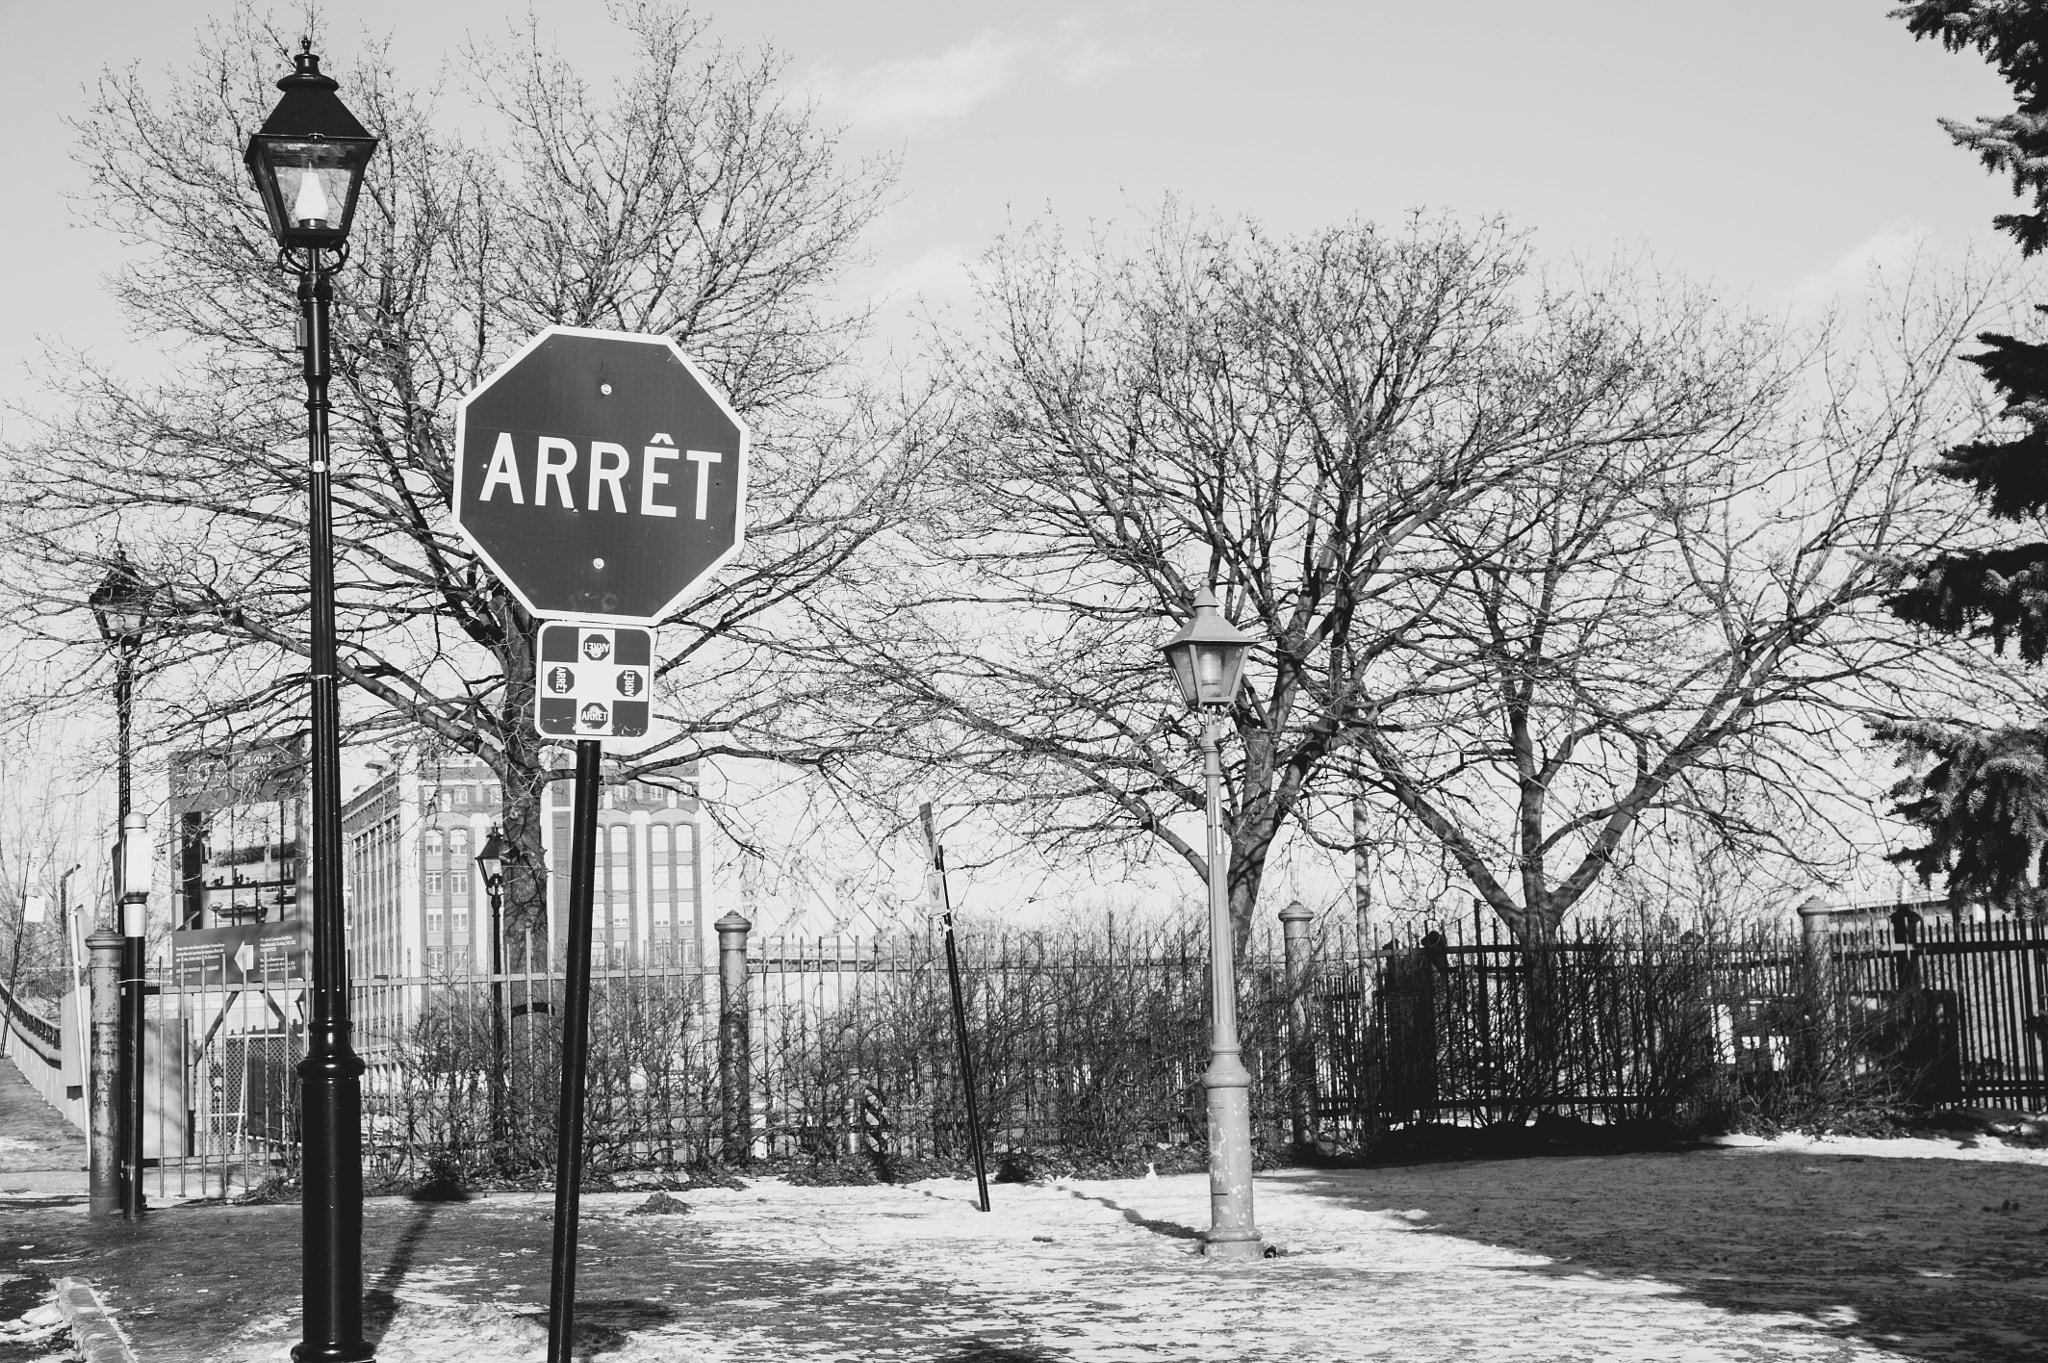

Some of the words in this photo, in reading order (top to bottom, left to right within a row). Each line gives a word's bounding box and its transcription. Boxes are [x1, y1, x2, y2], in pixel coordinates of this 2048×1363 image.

[479, 432, 722, 520] ARRÊT
[555, 667, 568, 694] ARRÊT
[623, 670, 635, 697] ARRÊT
